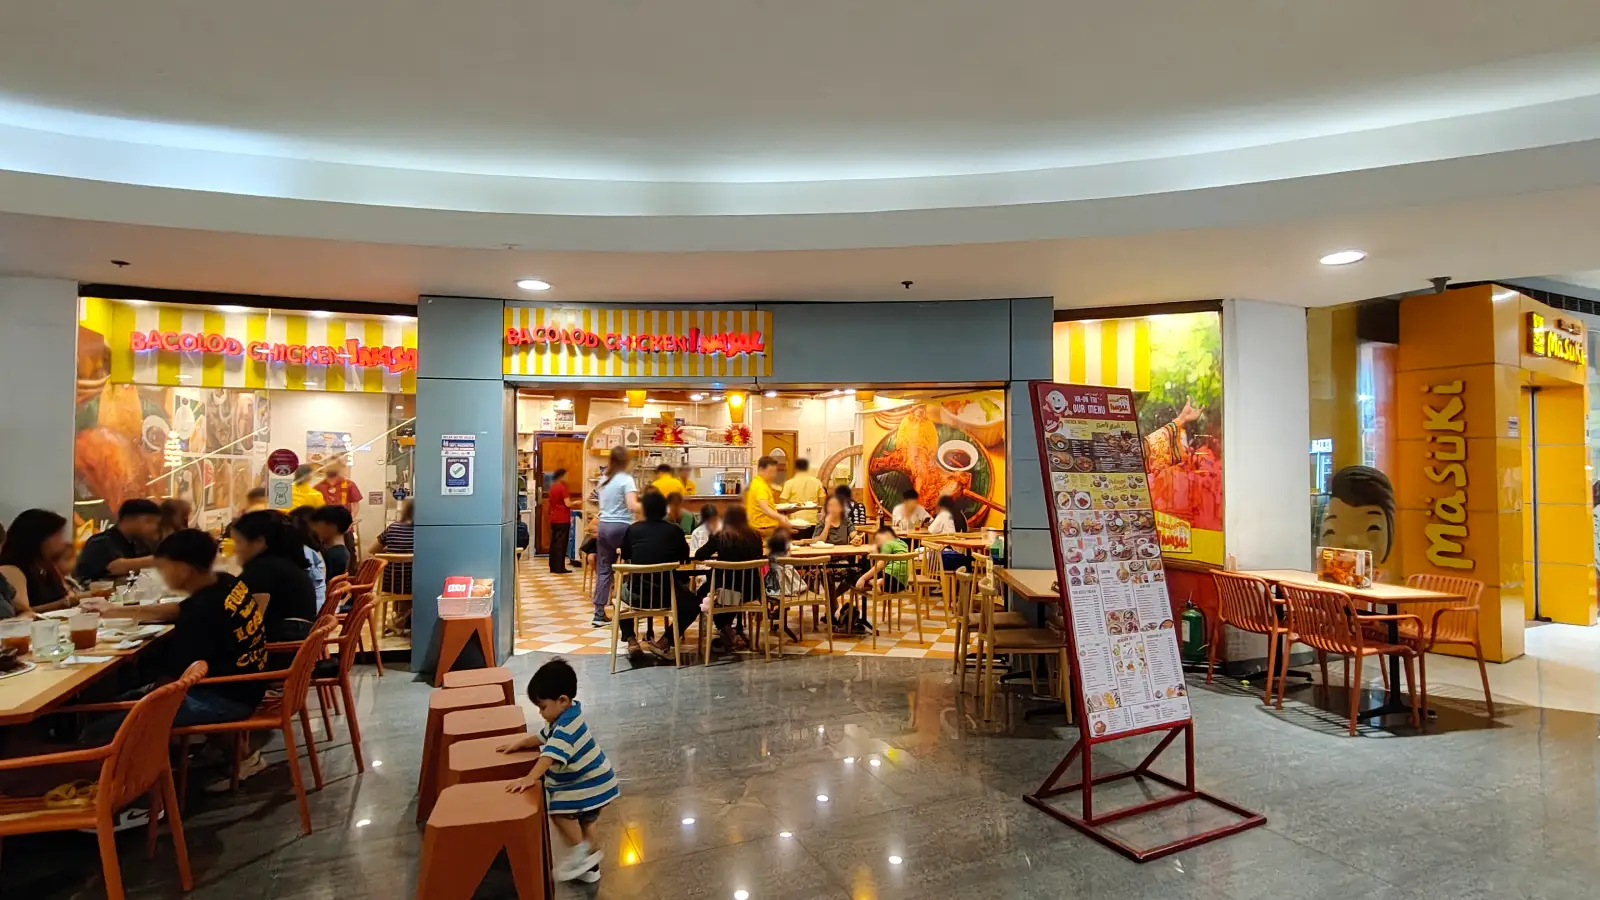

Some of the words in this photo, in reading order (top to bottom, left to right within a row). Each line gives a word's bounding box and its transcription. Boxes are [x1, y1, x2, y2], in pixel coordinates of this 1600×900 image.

[130, 330, 244, 355] BACOLOD
[246, 340, 347, 365] CHICKEN
[506, 326, 598, 348] BACOLOD
[603, 333, 688, 353] CHICKEN
[1087, 405, 1106, 415] MENU
